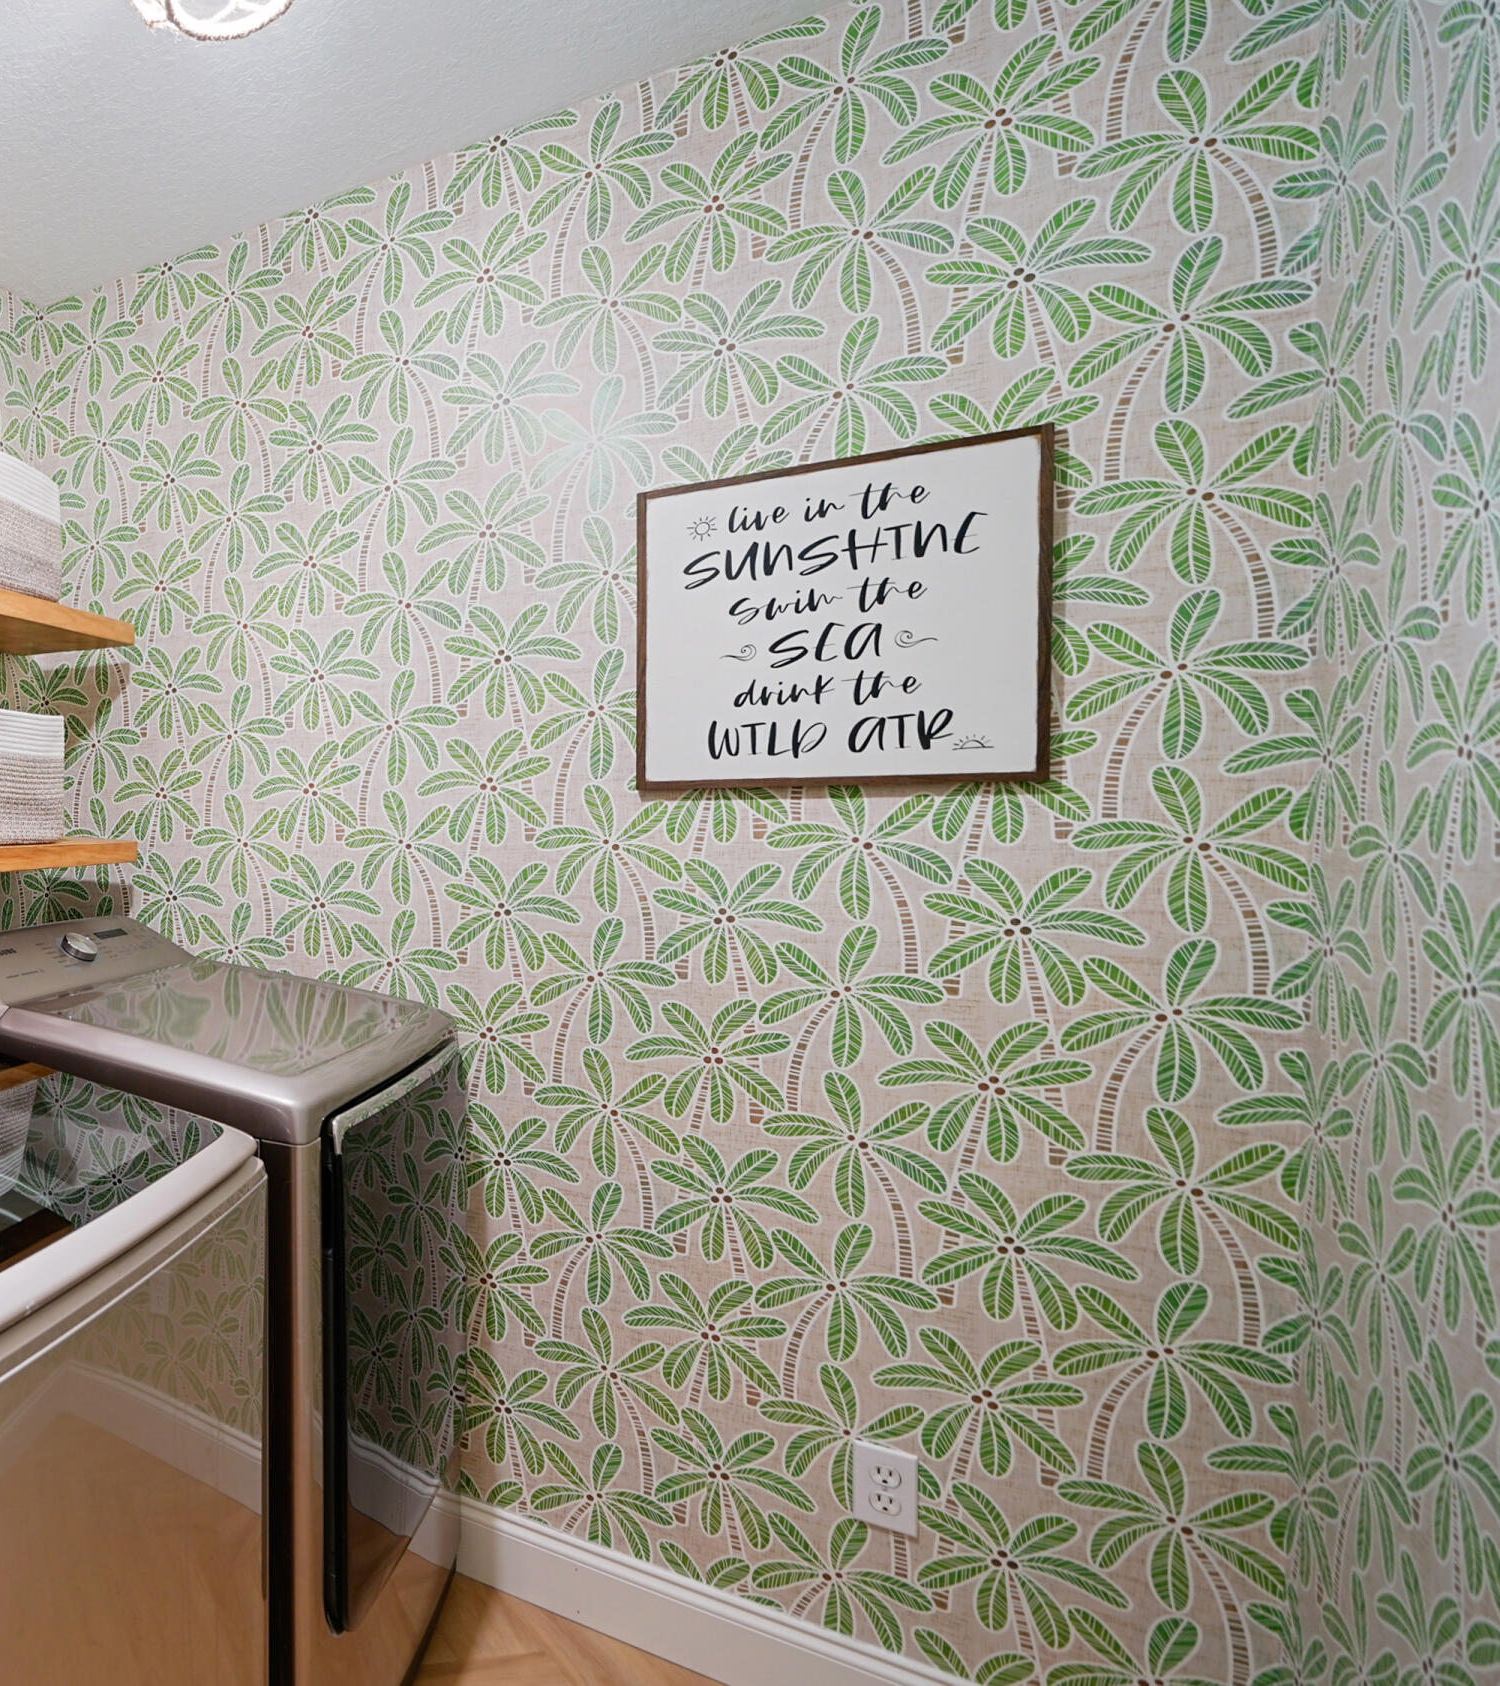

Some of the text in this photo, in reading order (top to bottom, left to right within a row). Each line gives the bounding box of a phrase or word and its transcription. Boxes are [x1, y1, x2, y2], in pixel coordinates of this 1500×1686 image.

[728, 482, 931, 534] live in the
[845, 576, 929, 613] the
[768, 622, 883, 669] SEA
[733, 669, 923, 708] drink the
[707, 708, 955, 760] WILD AIR
